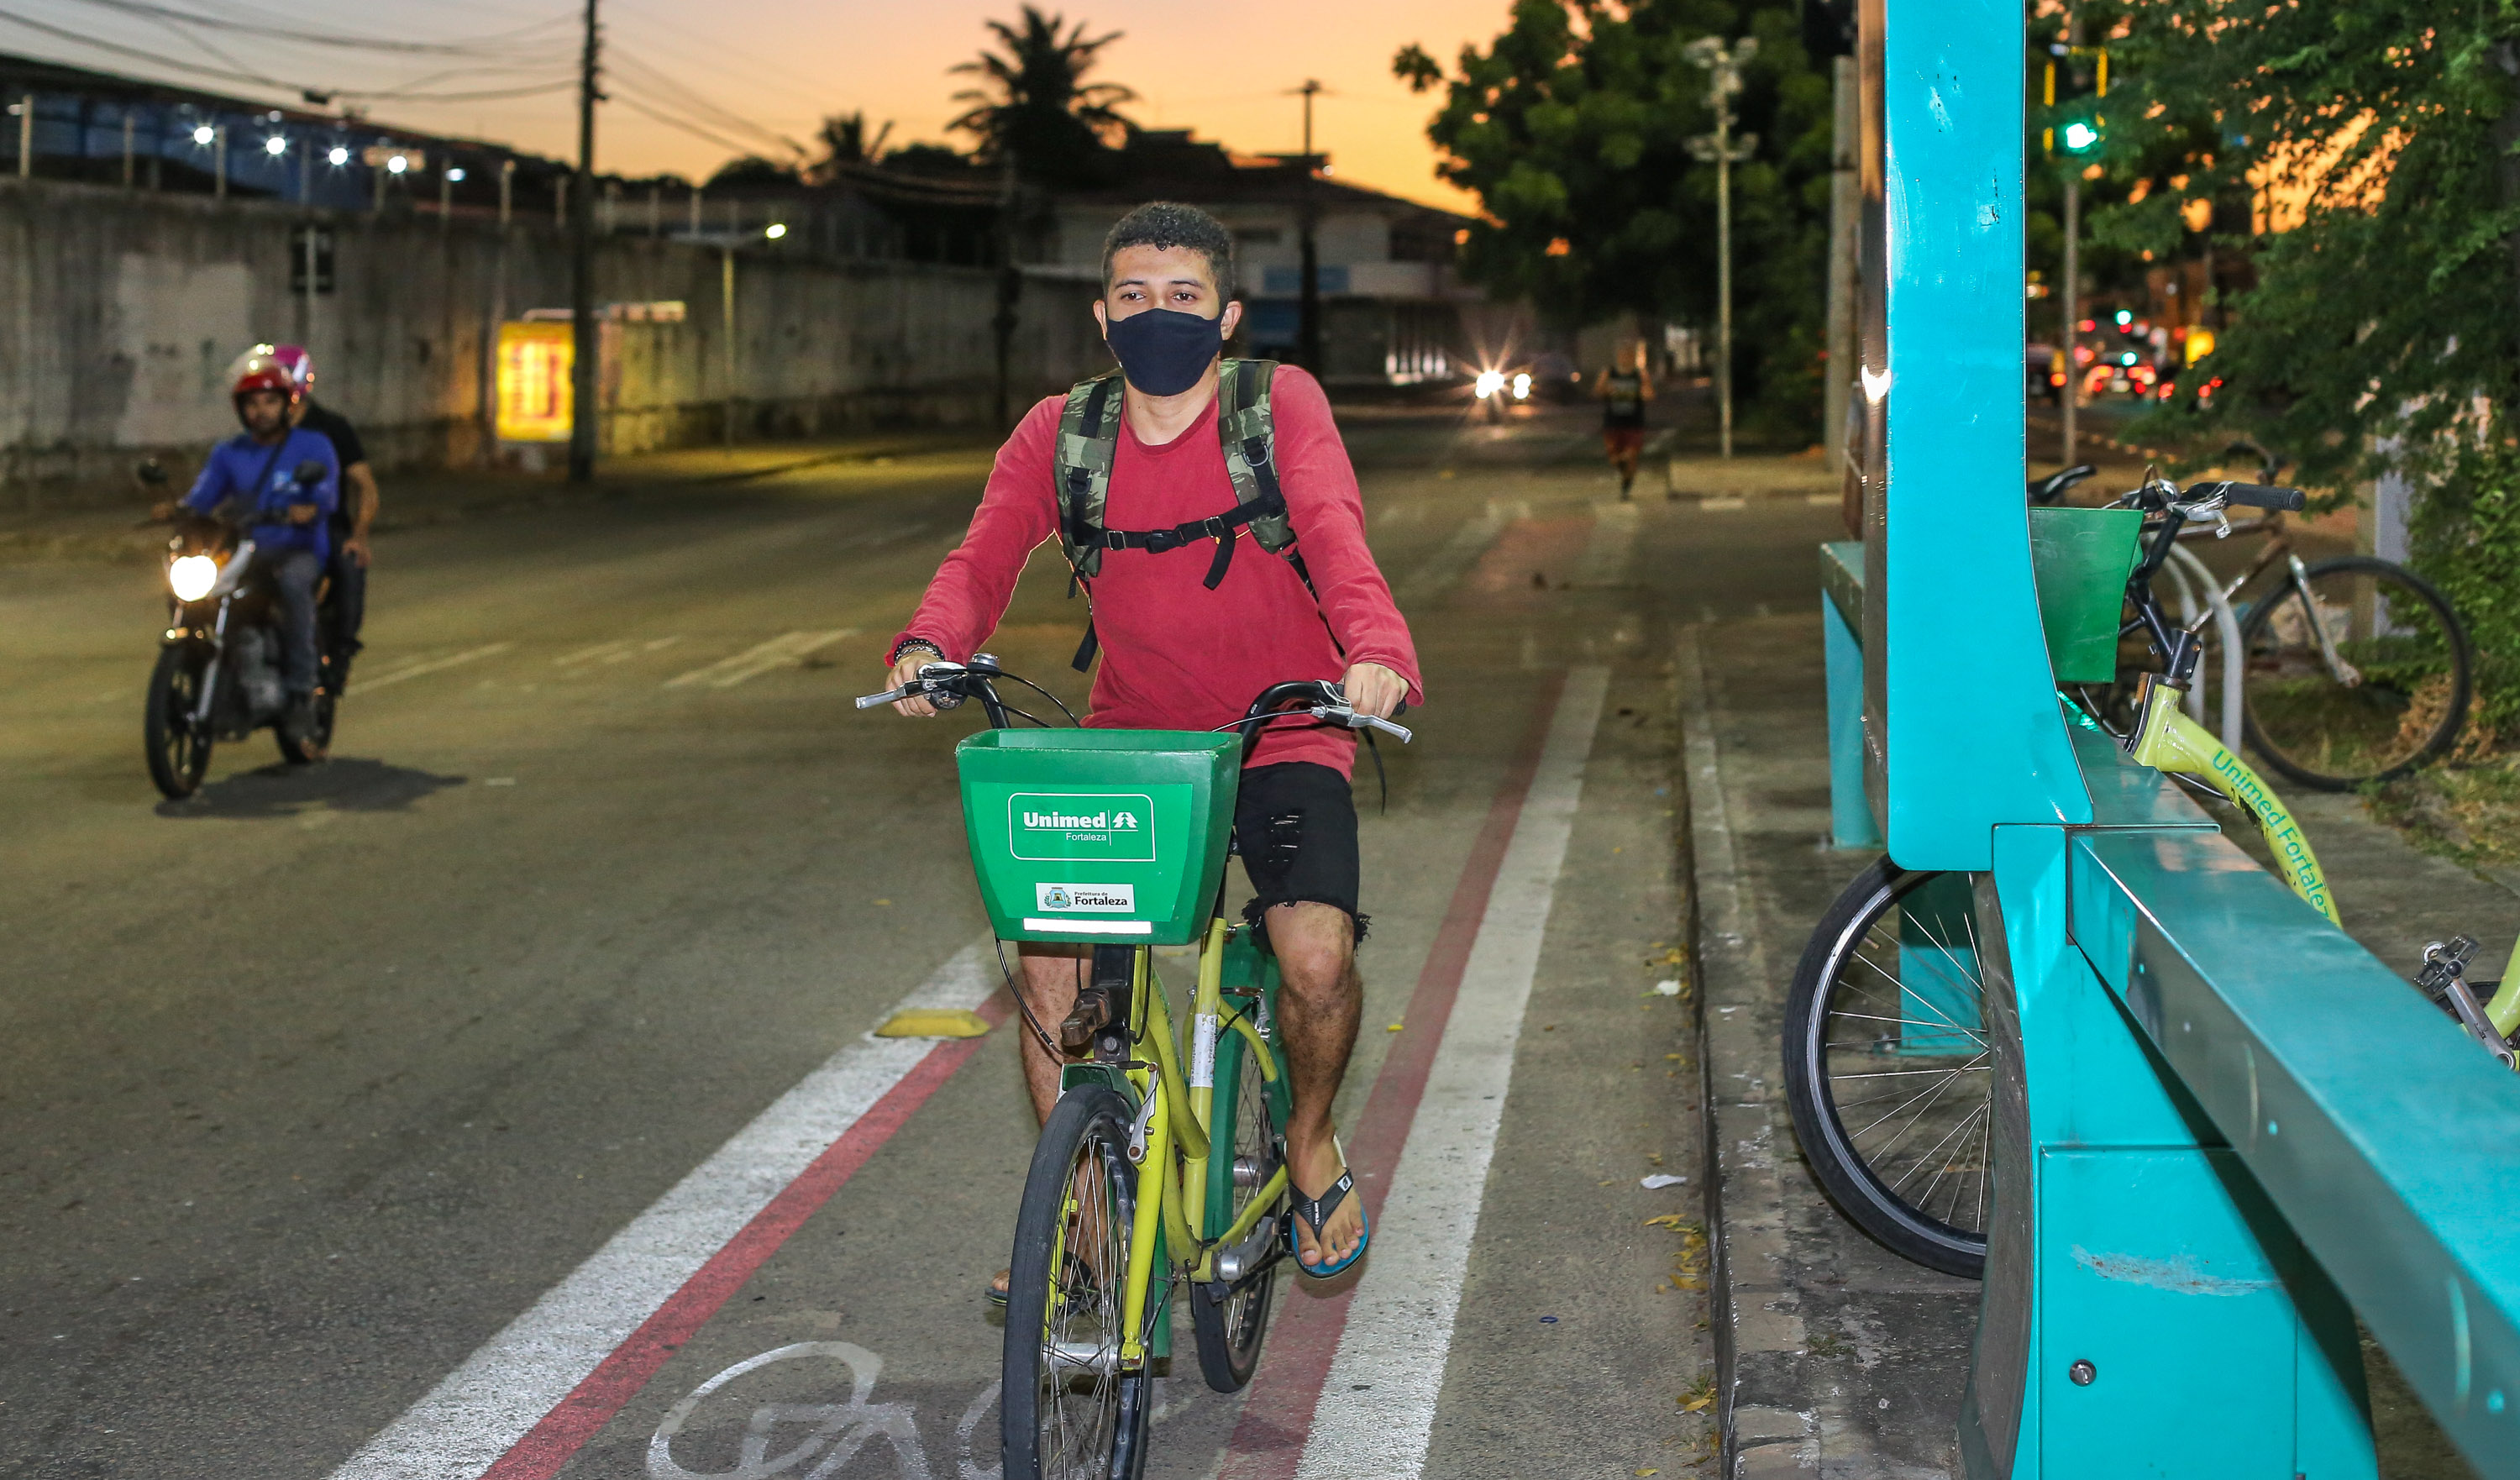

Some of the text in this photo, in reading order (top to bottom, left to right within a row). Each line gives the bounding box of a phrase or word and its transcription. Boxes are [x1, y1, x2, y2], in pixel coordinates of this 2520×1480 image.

[1023, 811, 1106, 828] Unimed
[1066, 832, 1107, 842] Fortaleza
[2212, 750, 2330, 918] Unimed Fortalez
[1074, 896, 1128, 906] Fortaleza
